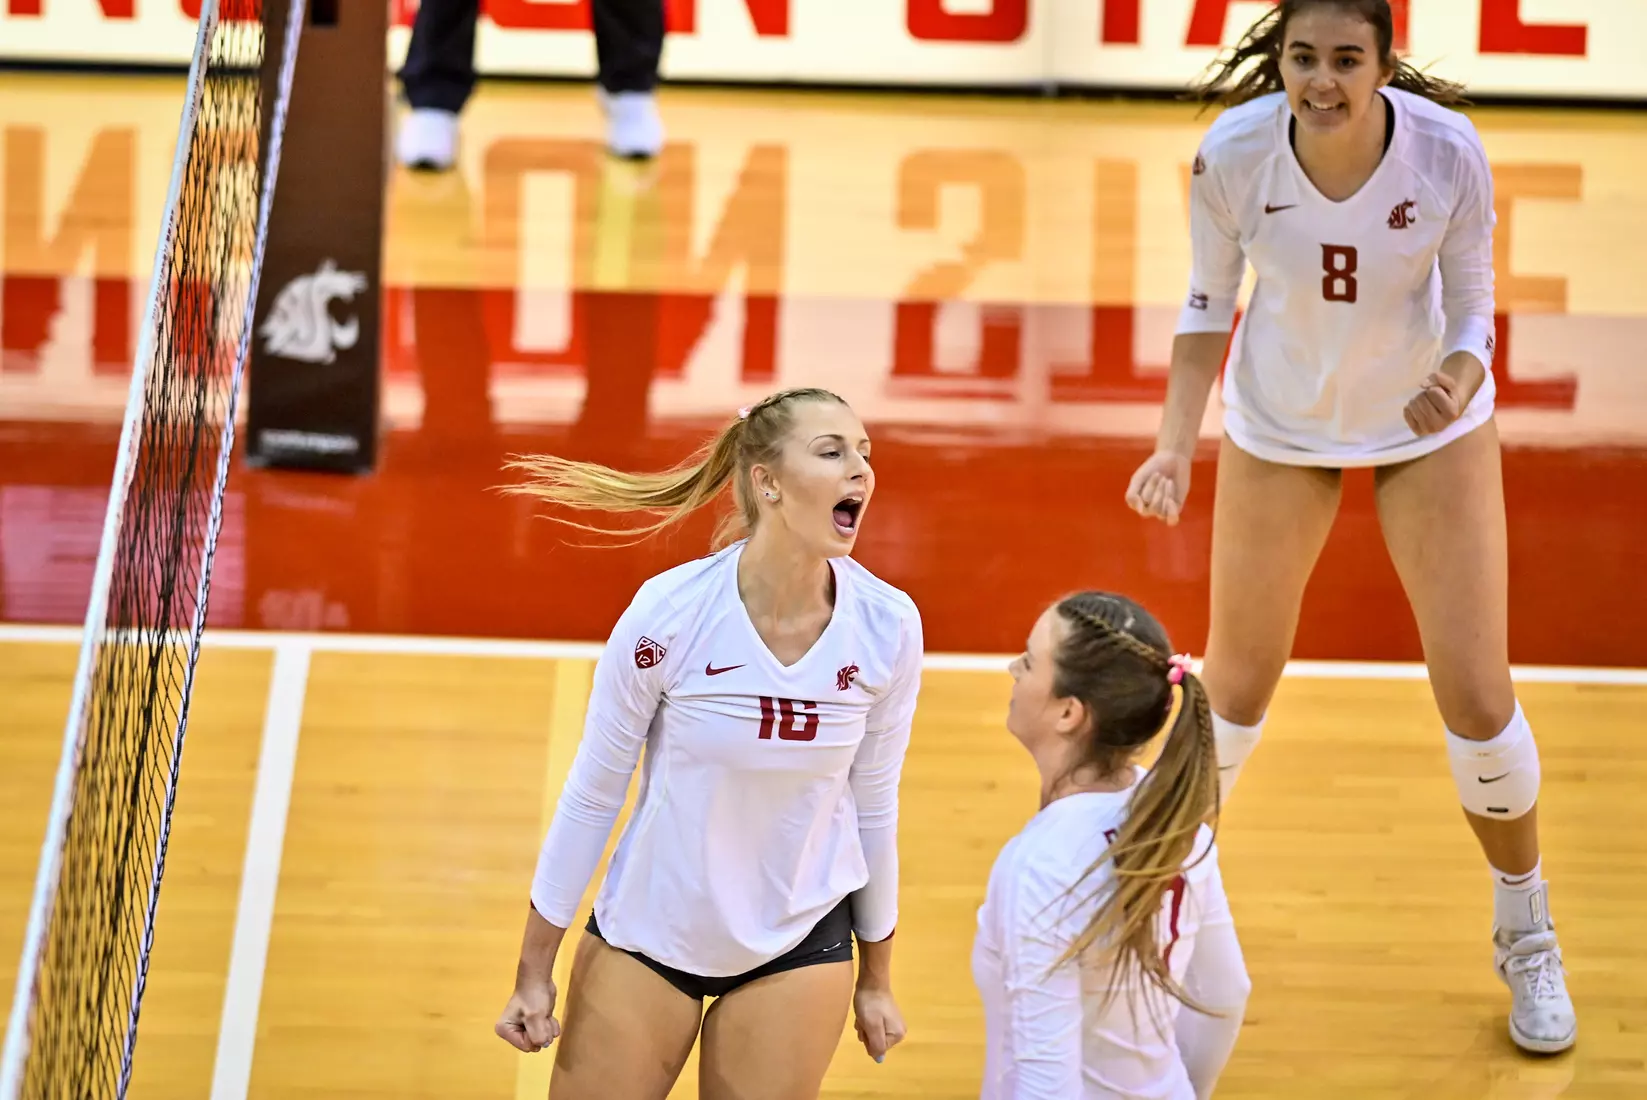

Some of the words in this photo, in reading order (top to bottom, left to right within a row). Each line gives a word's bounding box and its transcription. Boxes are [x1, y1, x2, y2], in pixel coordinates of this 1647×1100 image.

[1320, 243, 1358, 304] 8
[636, 637, 666, 664] PAC
[637, 654, 651, 667] 12
[758, 695, 819, 741] 16
